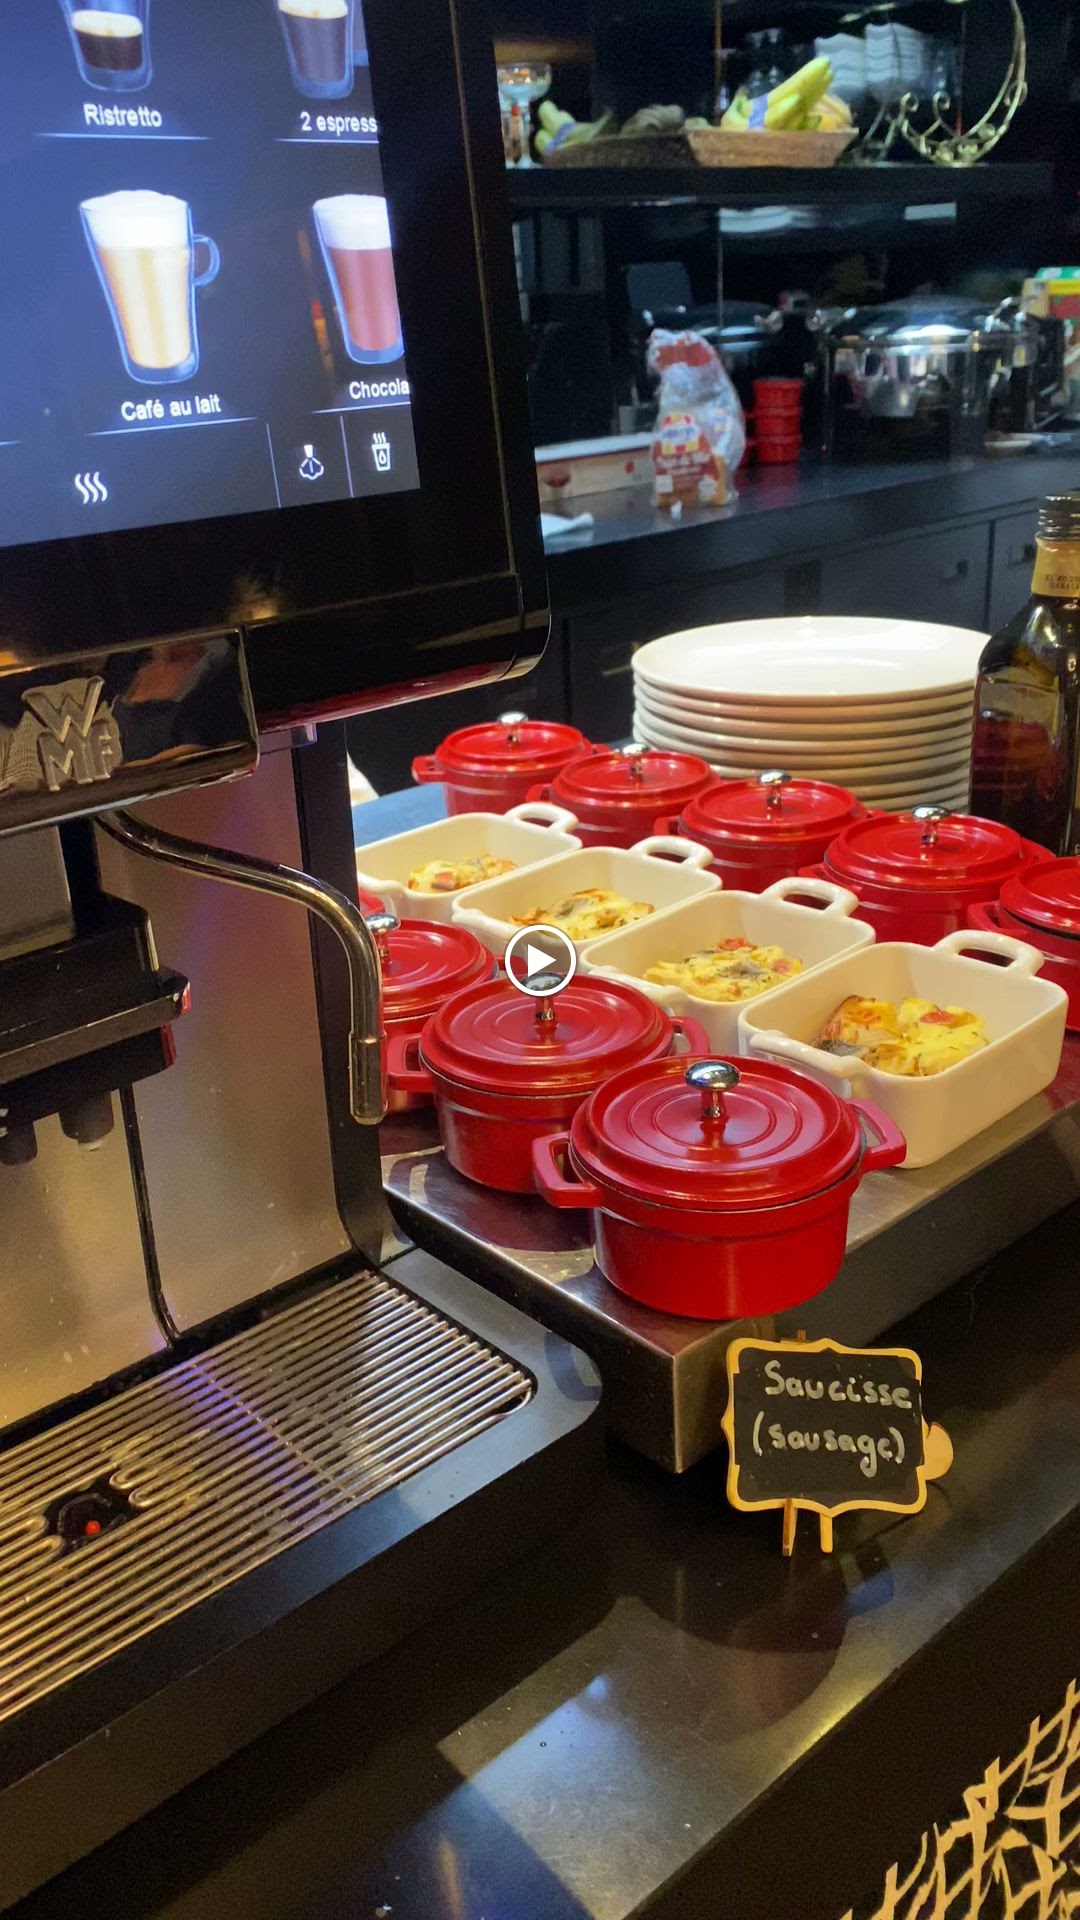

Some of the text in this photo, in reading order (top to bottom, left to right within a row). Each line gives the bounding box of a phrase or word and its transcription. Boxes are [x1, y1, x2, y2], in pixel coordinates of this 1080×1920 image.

[83, 104, 163, 127] Ristretto
[300, 111, 312, 131] 2
[120, 394, 222, 421] Café au lait
[764, 1359, 913, 1409] Saucisse
[752, 1410, 906, 1479] (sausage)
